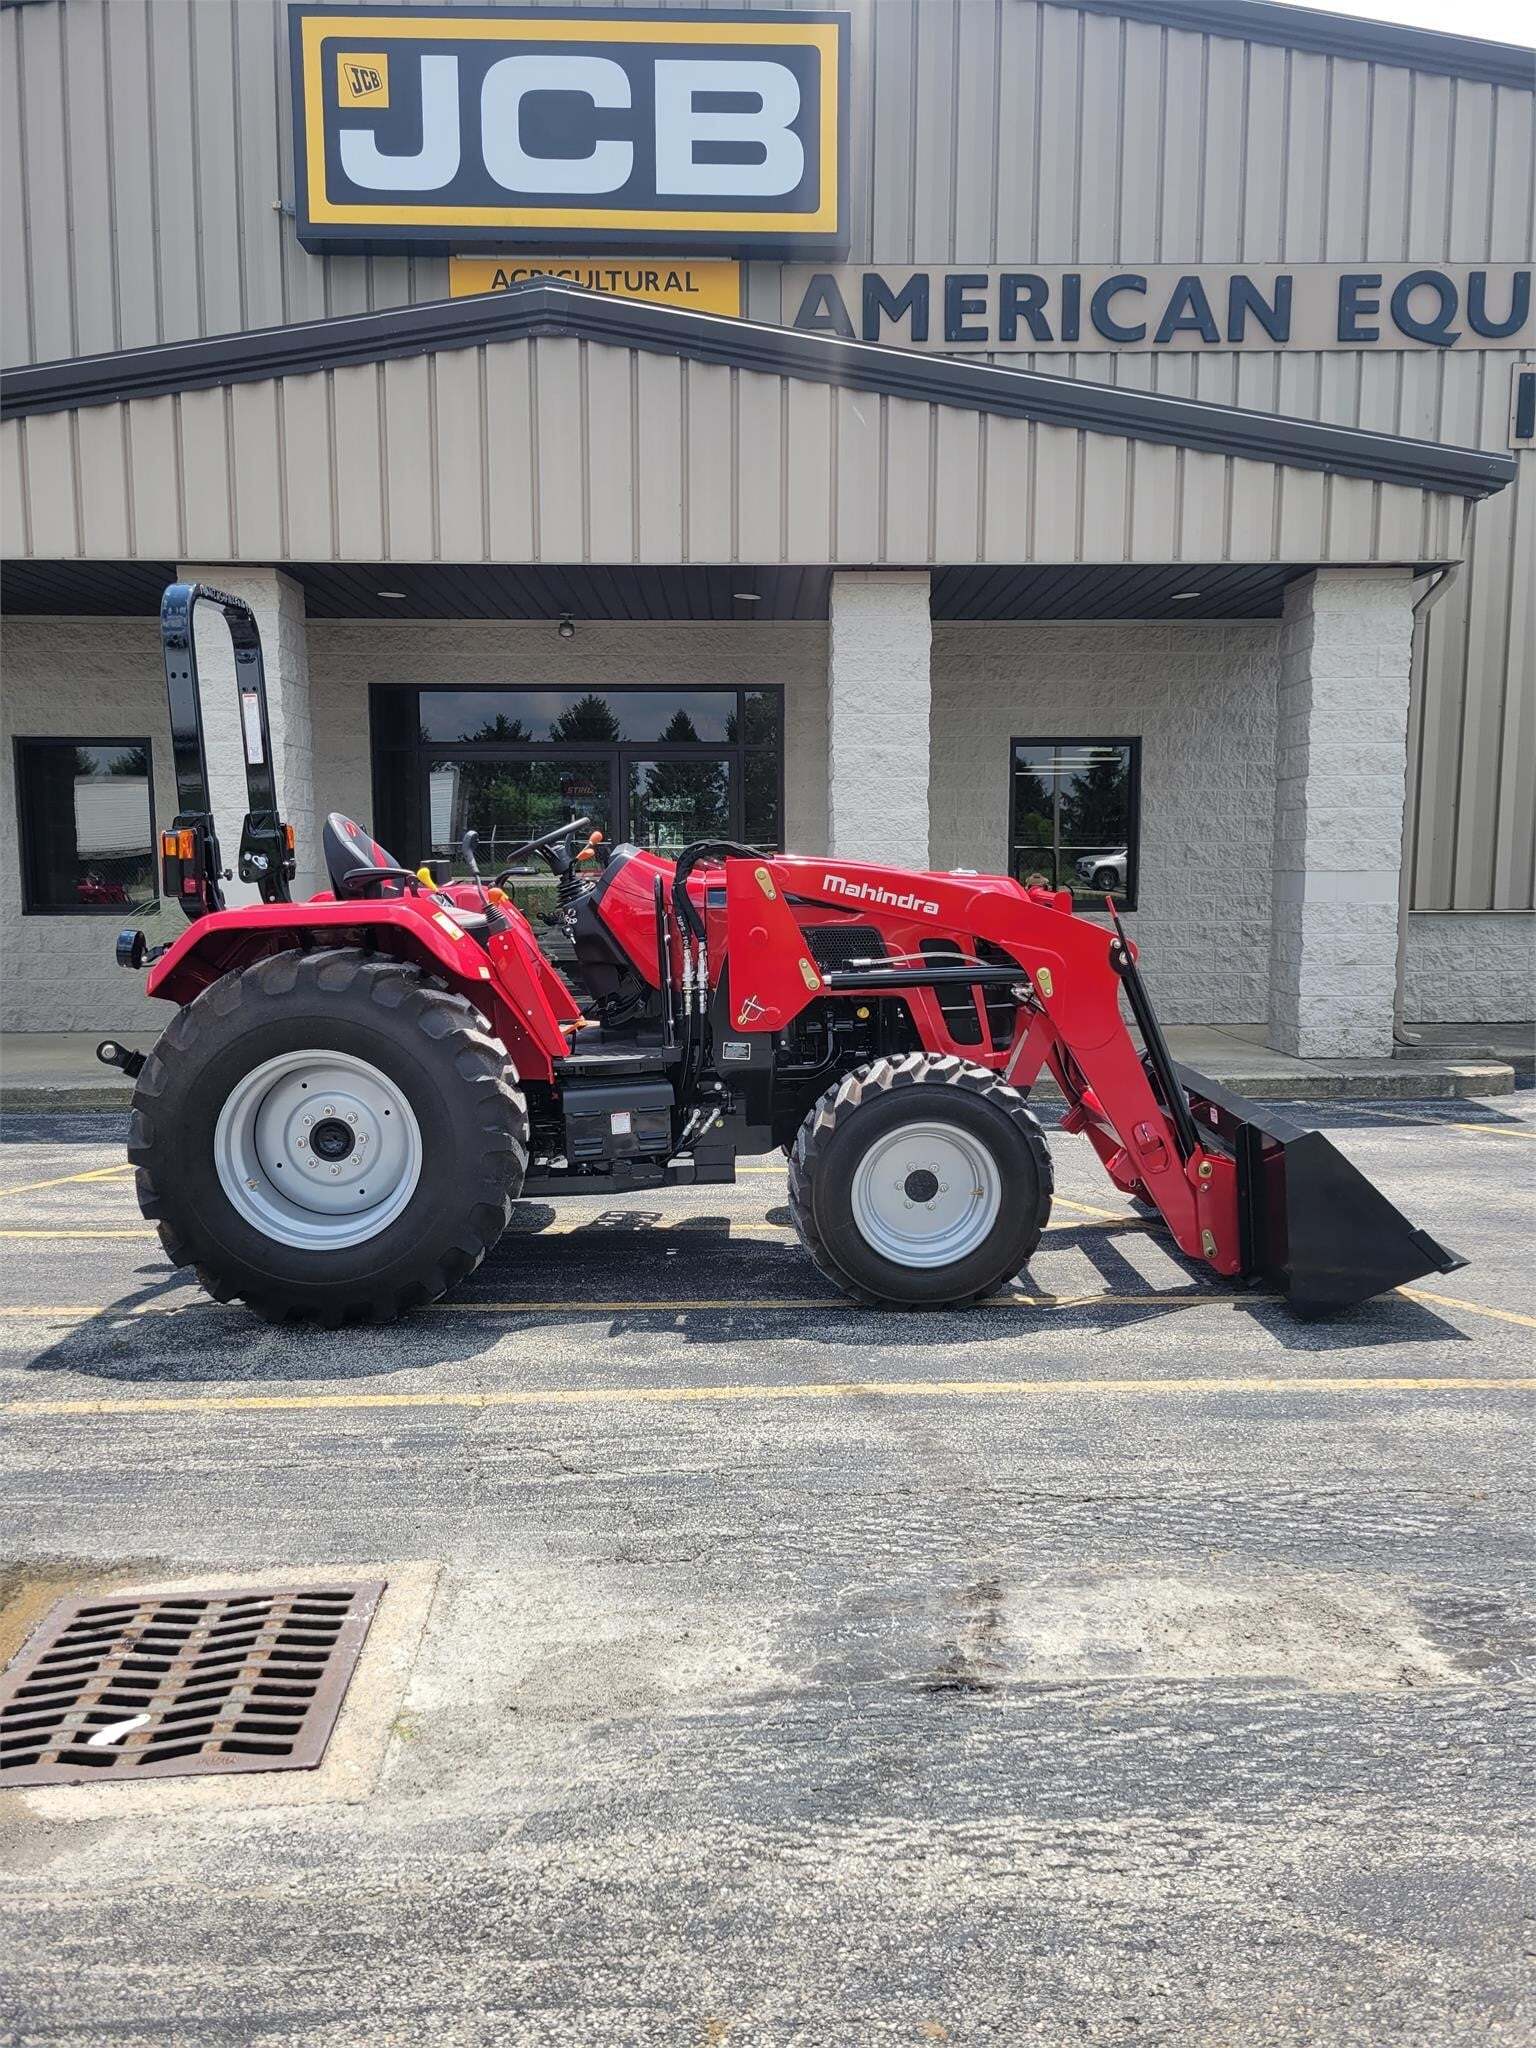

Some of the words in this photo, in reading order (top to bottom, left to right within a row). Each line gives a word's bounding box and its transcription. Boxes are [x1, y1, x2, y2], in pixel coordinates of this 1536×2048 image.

[351, 67, 380, 94] JCB
[339, 55, 804, 195] JCB
[793, 272, 1293, 343] AMERICAN
[822, 874, 939, 915] Mahindra
